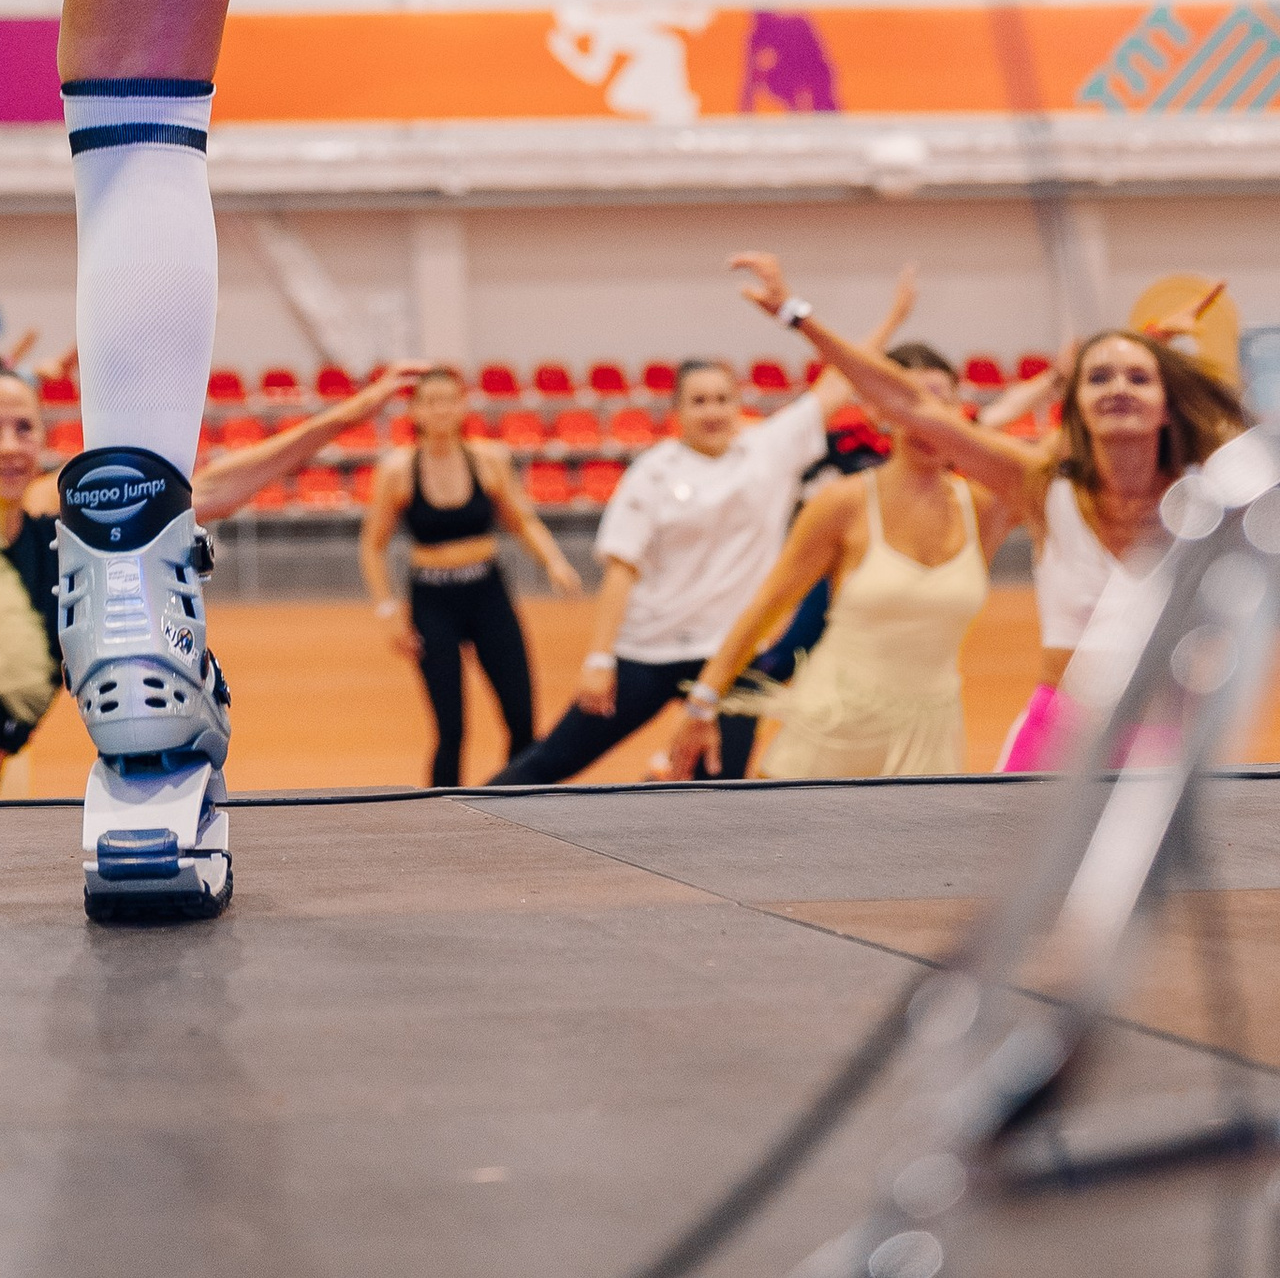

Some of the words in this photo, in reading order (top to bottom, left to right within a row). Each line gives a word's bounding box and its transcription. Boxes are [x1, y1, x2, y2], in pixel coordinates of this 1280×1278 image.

[65, 487, 120, 508] Kangoo
[122, 478, 166, 503] Jumps
[110, 527, 122, 541] S
